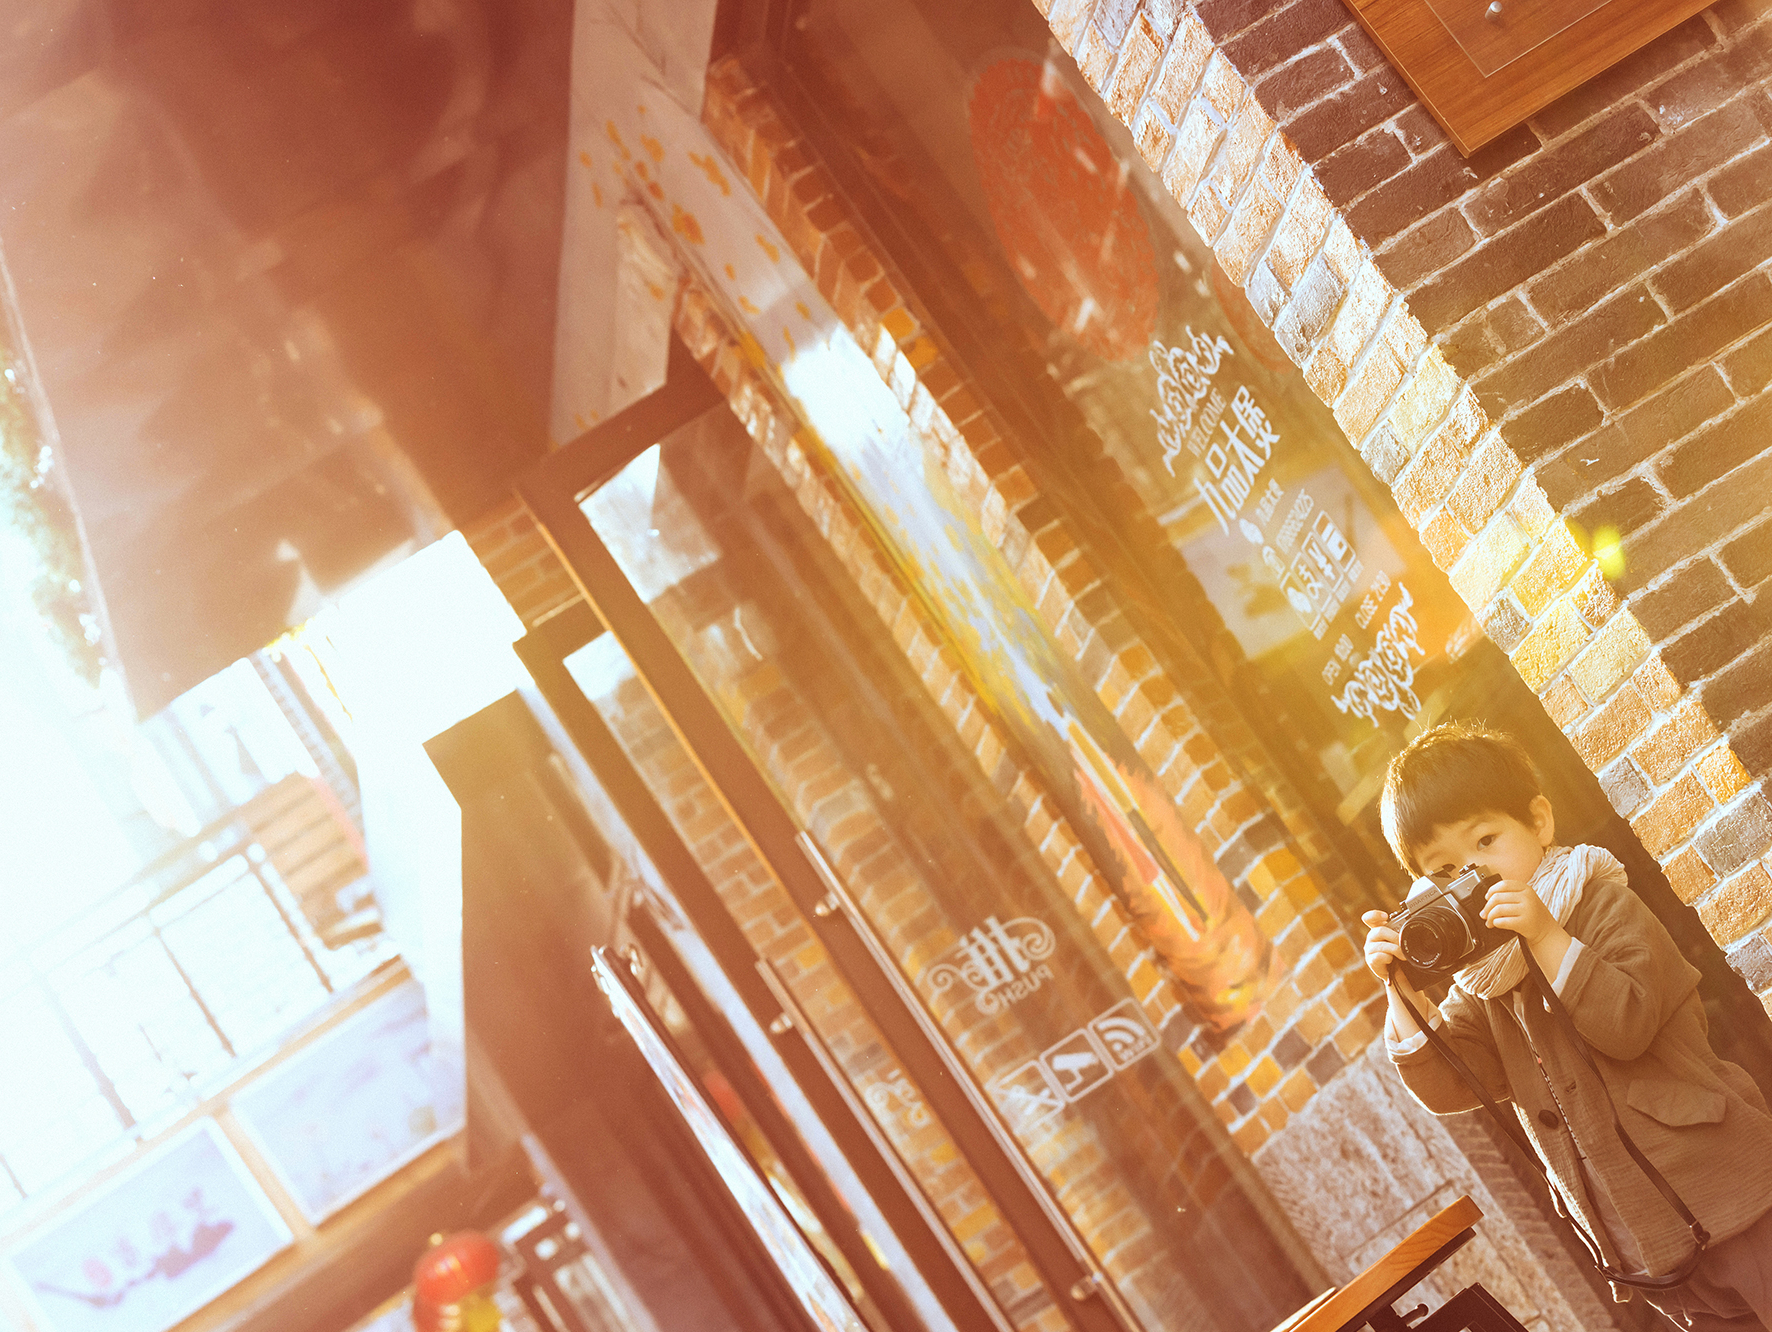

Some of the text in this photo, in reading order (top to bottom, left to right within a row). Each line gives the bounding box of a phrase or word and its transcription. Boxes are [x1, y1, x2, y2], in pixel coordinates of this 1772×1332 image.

[1187, 387, 1226, 458] WELCOME
[1321, 657, 1341, 687] OPEN
[1354, 594, 1377, 630] CLOSE
